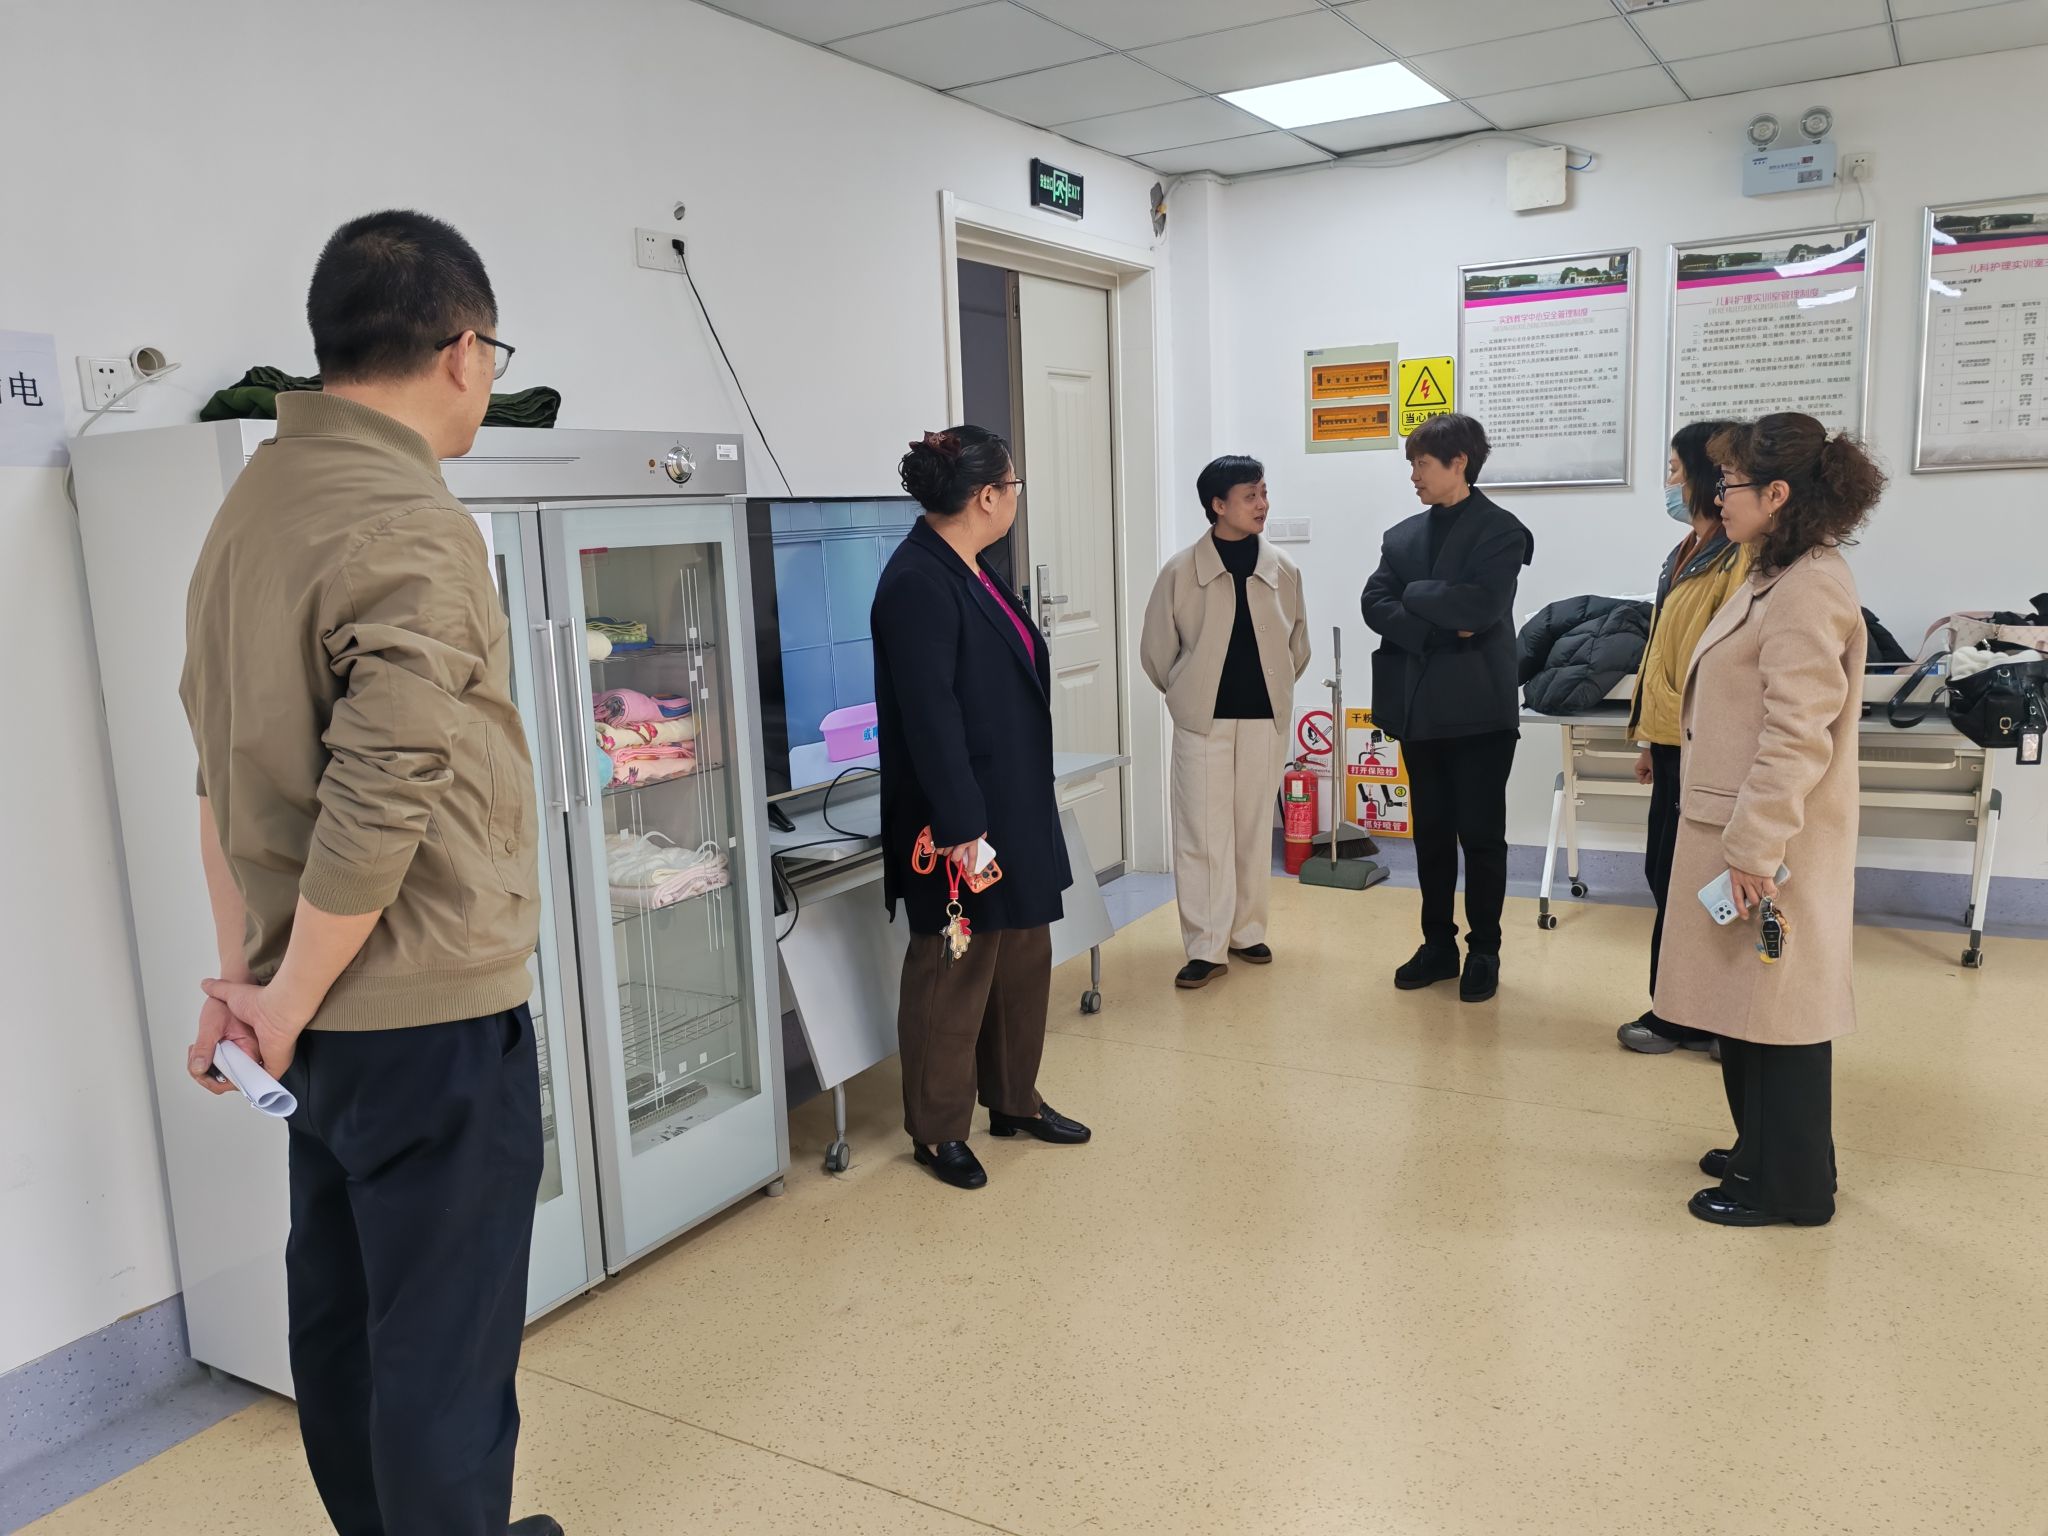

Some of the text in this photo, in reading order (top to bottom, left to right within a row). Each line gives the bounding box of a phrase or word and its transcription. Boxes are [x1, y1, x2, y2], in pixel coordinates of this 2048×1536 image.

[1068, 182, 1080, 200] EXIT
[0, 370, 43, 407] 电
[1351, 766, 1394, 776] 打开保险栓
